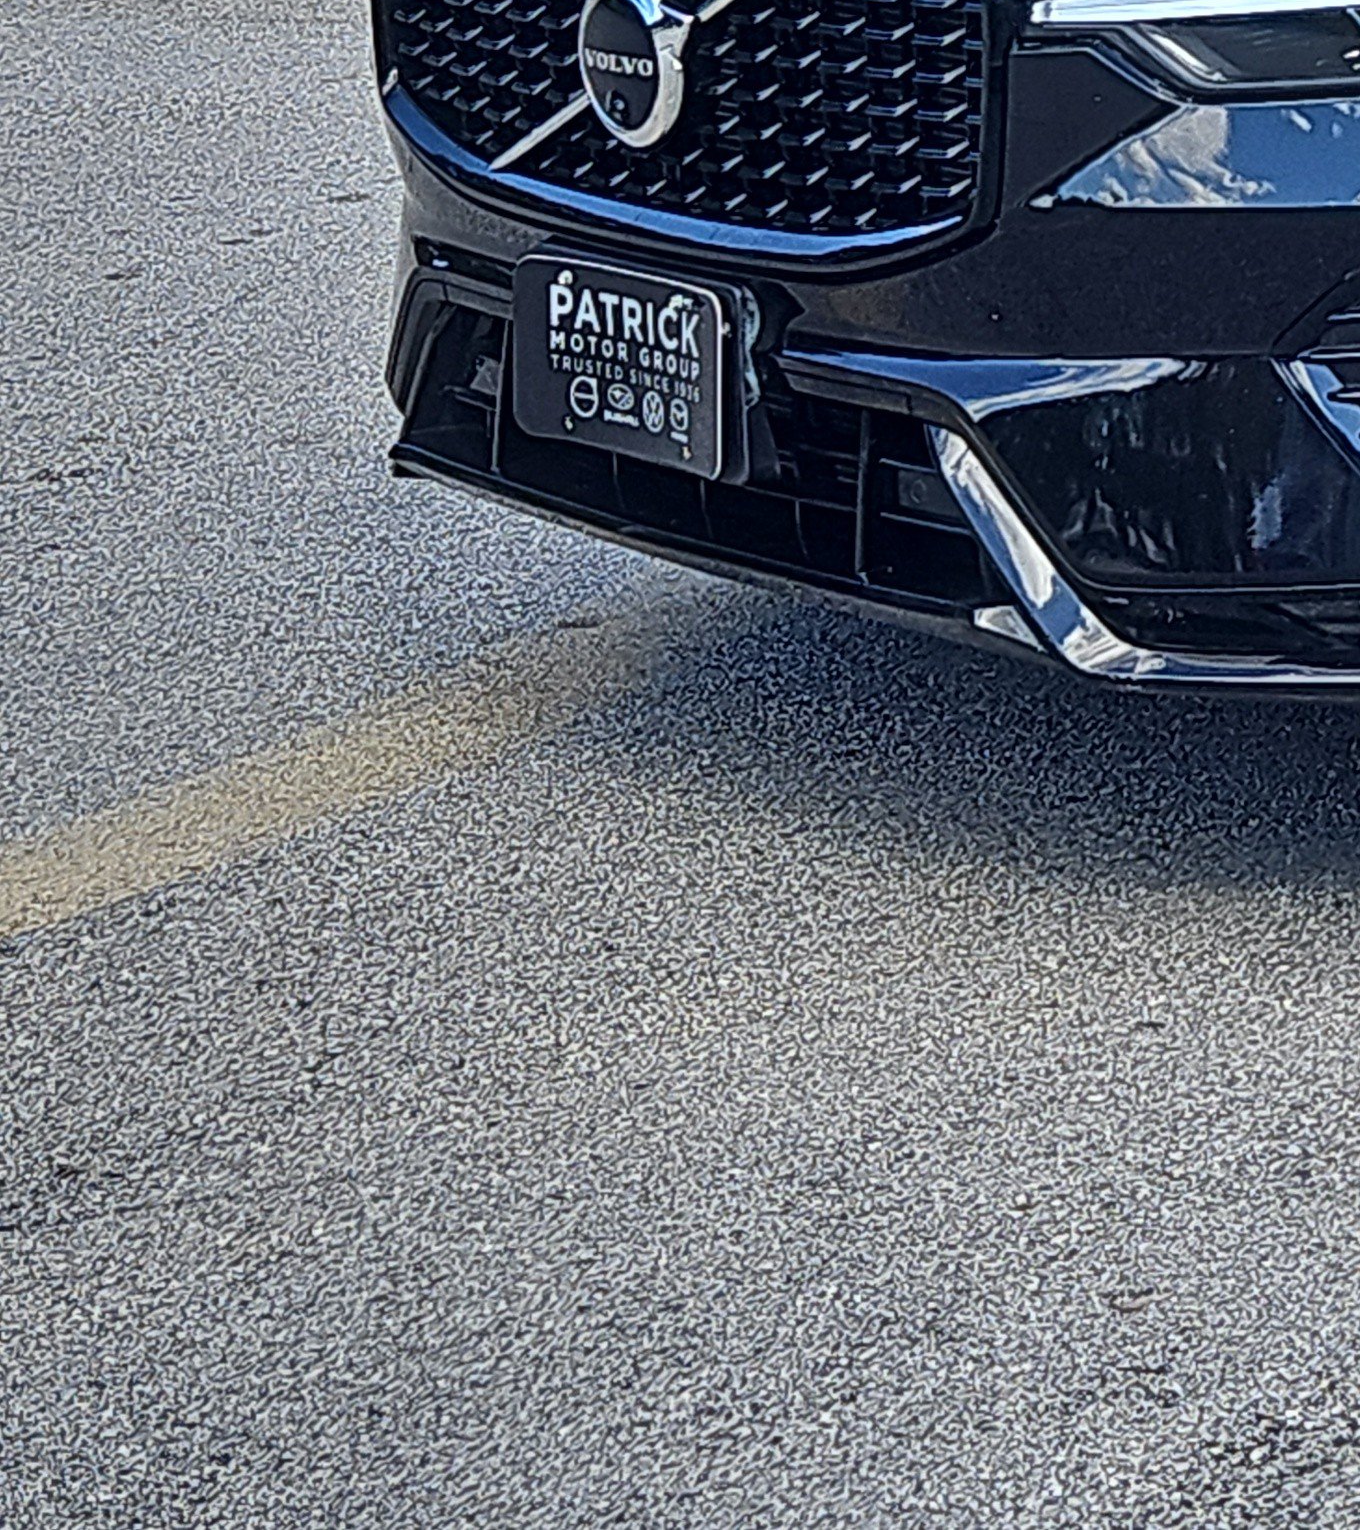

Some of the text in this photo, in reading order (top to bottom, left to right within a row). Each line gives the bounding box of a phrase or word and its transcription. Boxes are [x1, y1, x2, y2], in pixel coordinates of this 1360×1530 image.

[584, 47, 653, 77] VOLVO
[549, 284, 699, 358] PATRICK
[549, 329, 700, 382] MOTOR GROUP
[550, 354, 623, 381] TRUSTED
[629, 368, 670, 394] SINCE
